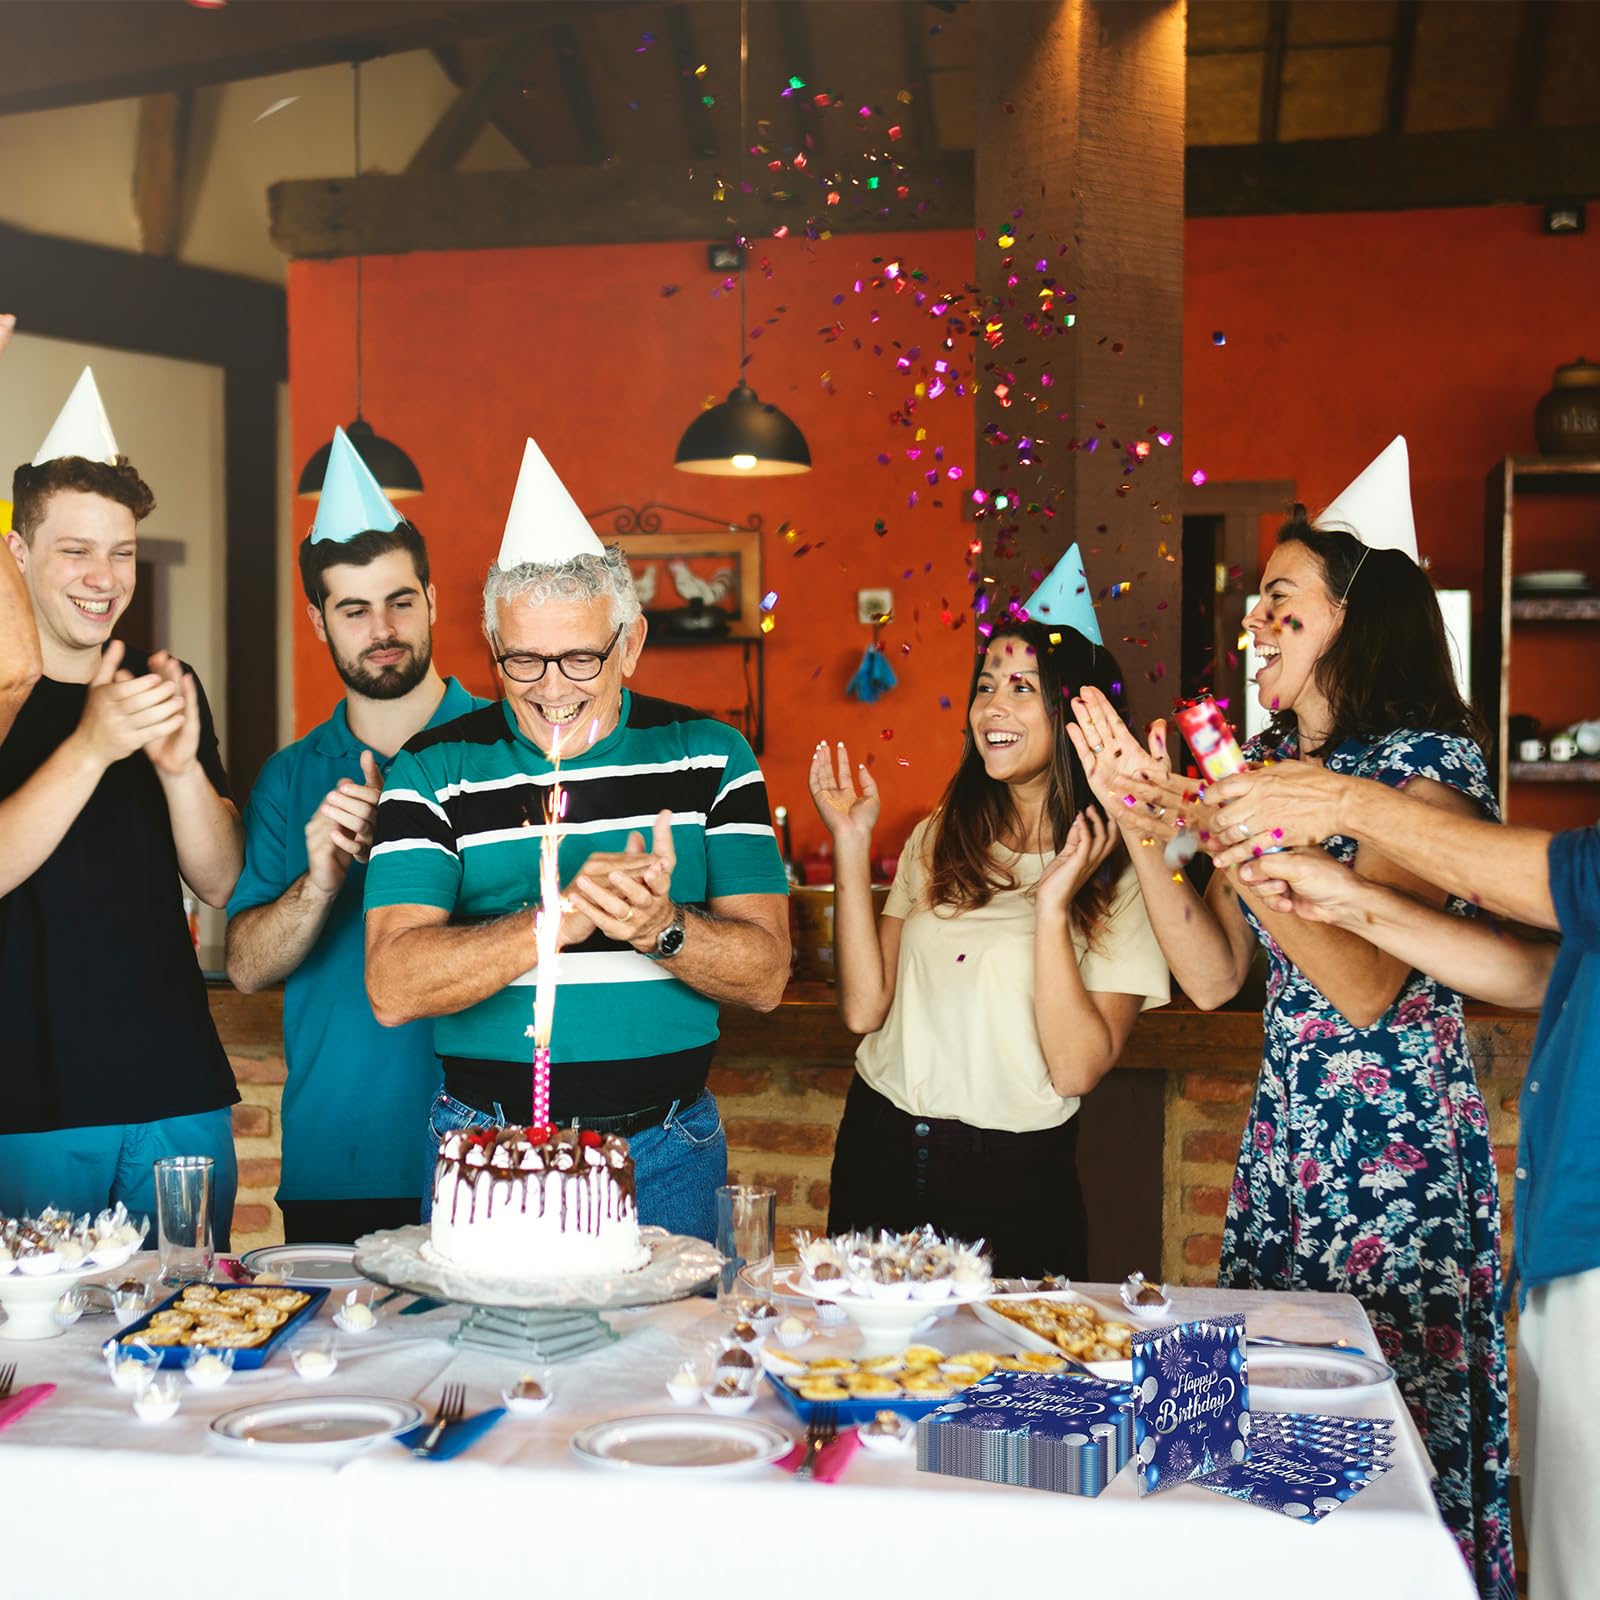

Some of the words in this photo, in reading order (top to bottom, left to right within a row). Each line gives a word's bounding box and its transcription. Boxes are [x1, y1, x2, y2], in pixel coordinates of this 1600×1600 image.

[1016, 1388, 1085, 1403] Happy
[1170, 1371, 1219, 1398] Happy
[975, 1393, 1106, 1418] Birthday
[1155, 1376, 1235, 1434] Birthday
[1188, 1423, 1197, 1435] To
